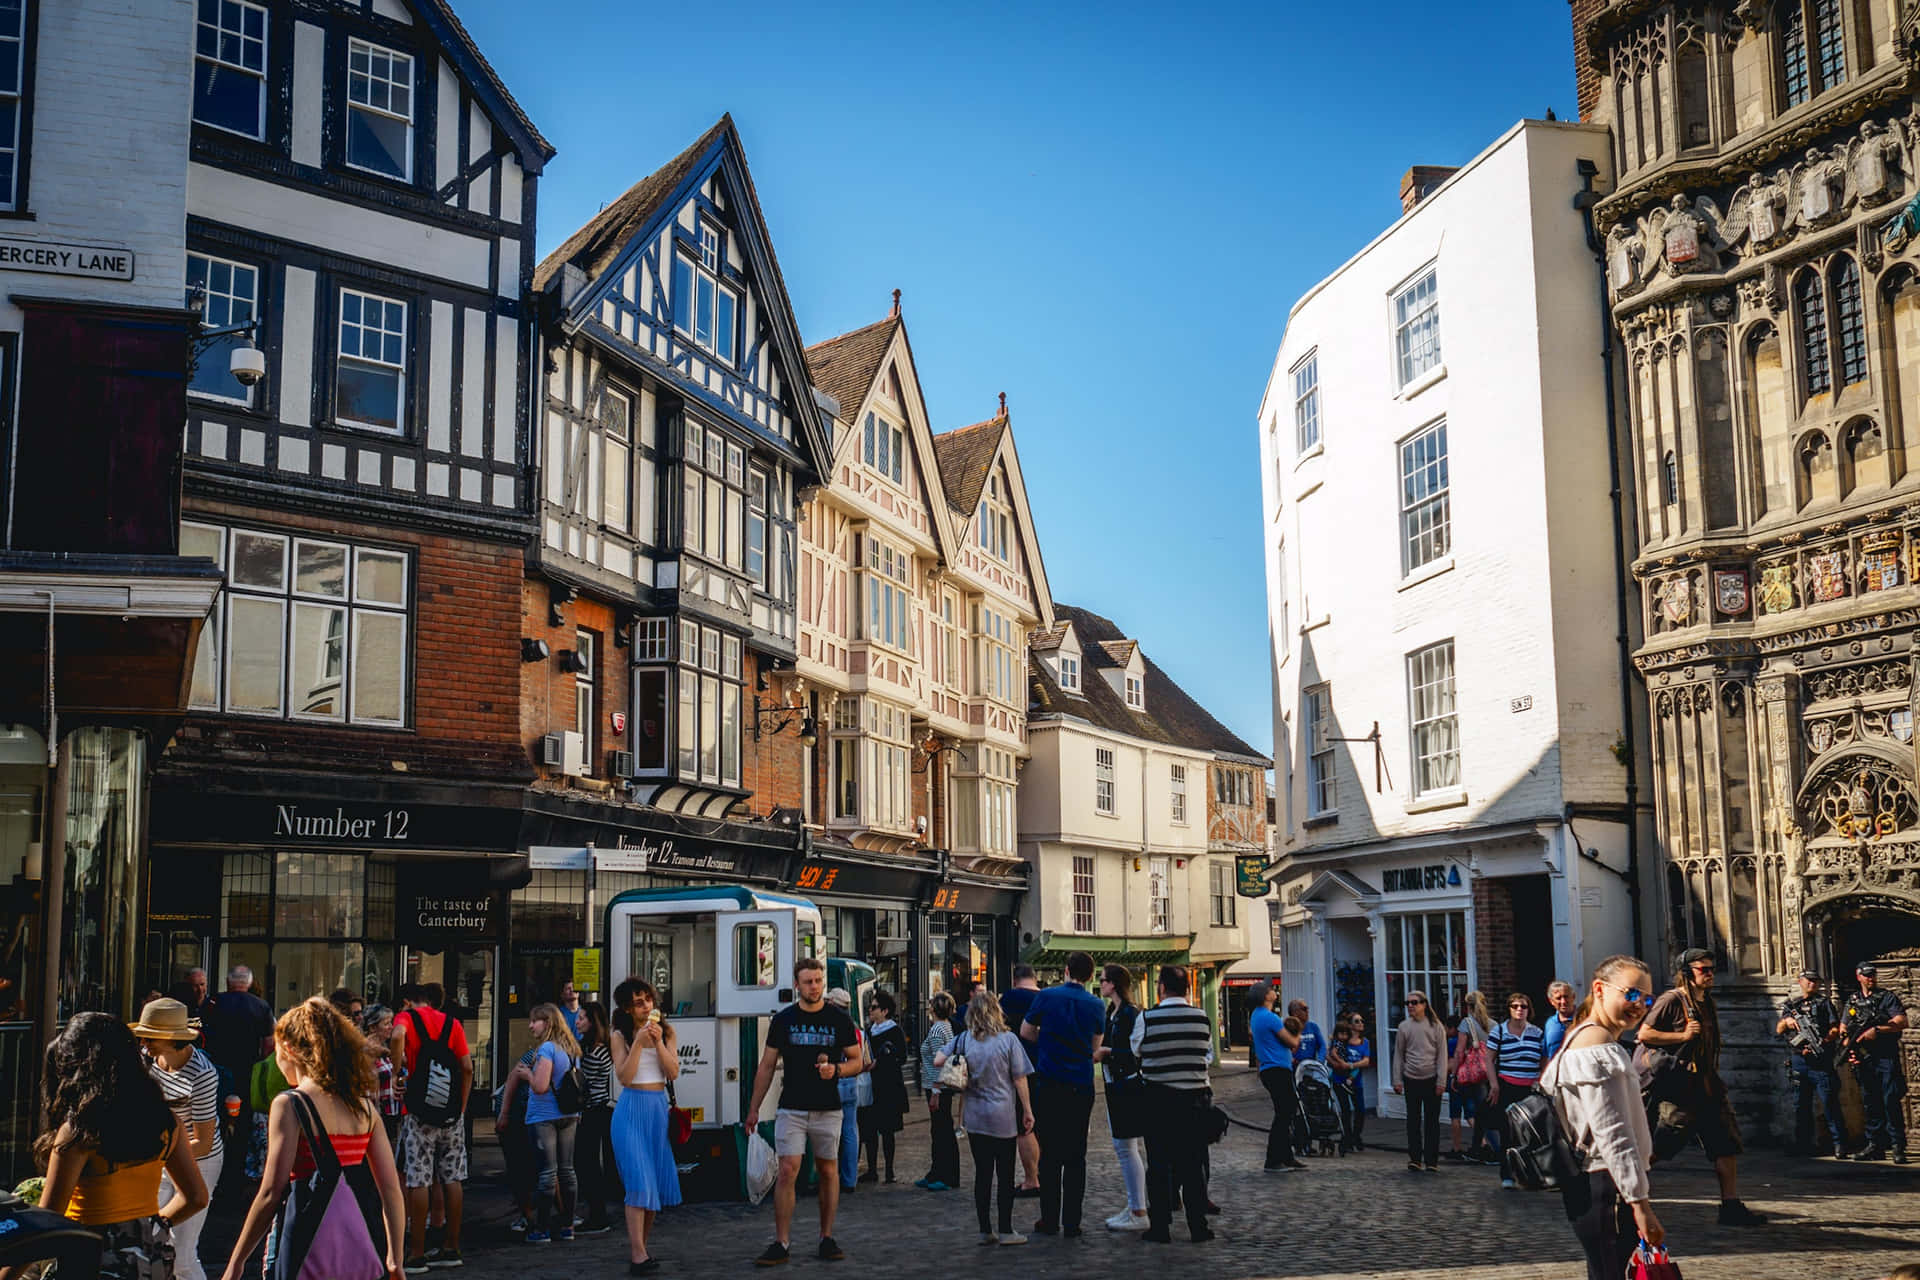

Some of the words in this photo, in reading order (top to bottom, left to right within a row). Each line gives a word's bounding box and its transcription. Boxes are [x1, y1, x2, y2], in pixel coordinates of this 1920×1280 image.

[78, 253, 126, 272] LANE
[1841, 617, 1873, 637] EST
[273, 804, 376, 838] Number
[383, 810, 409, 840] 12
[658, 840, 673, 864] 12
[416, 897, 438, 910] The
[444, 900, 471, 910] taste
[476, 897, 490, 911] of
[418, 913, 486, 931] Canterbury
[425, 1059, 451, 1109] NIKE
